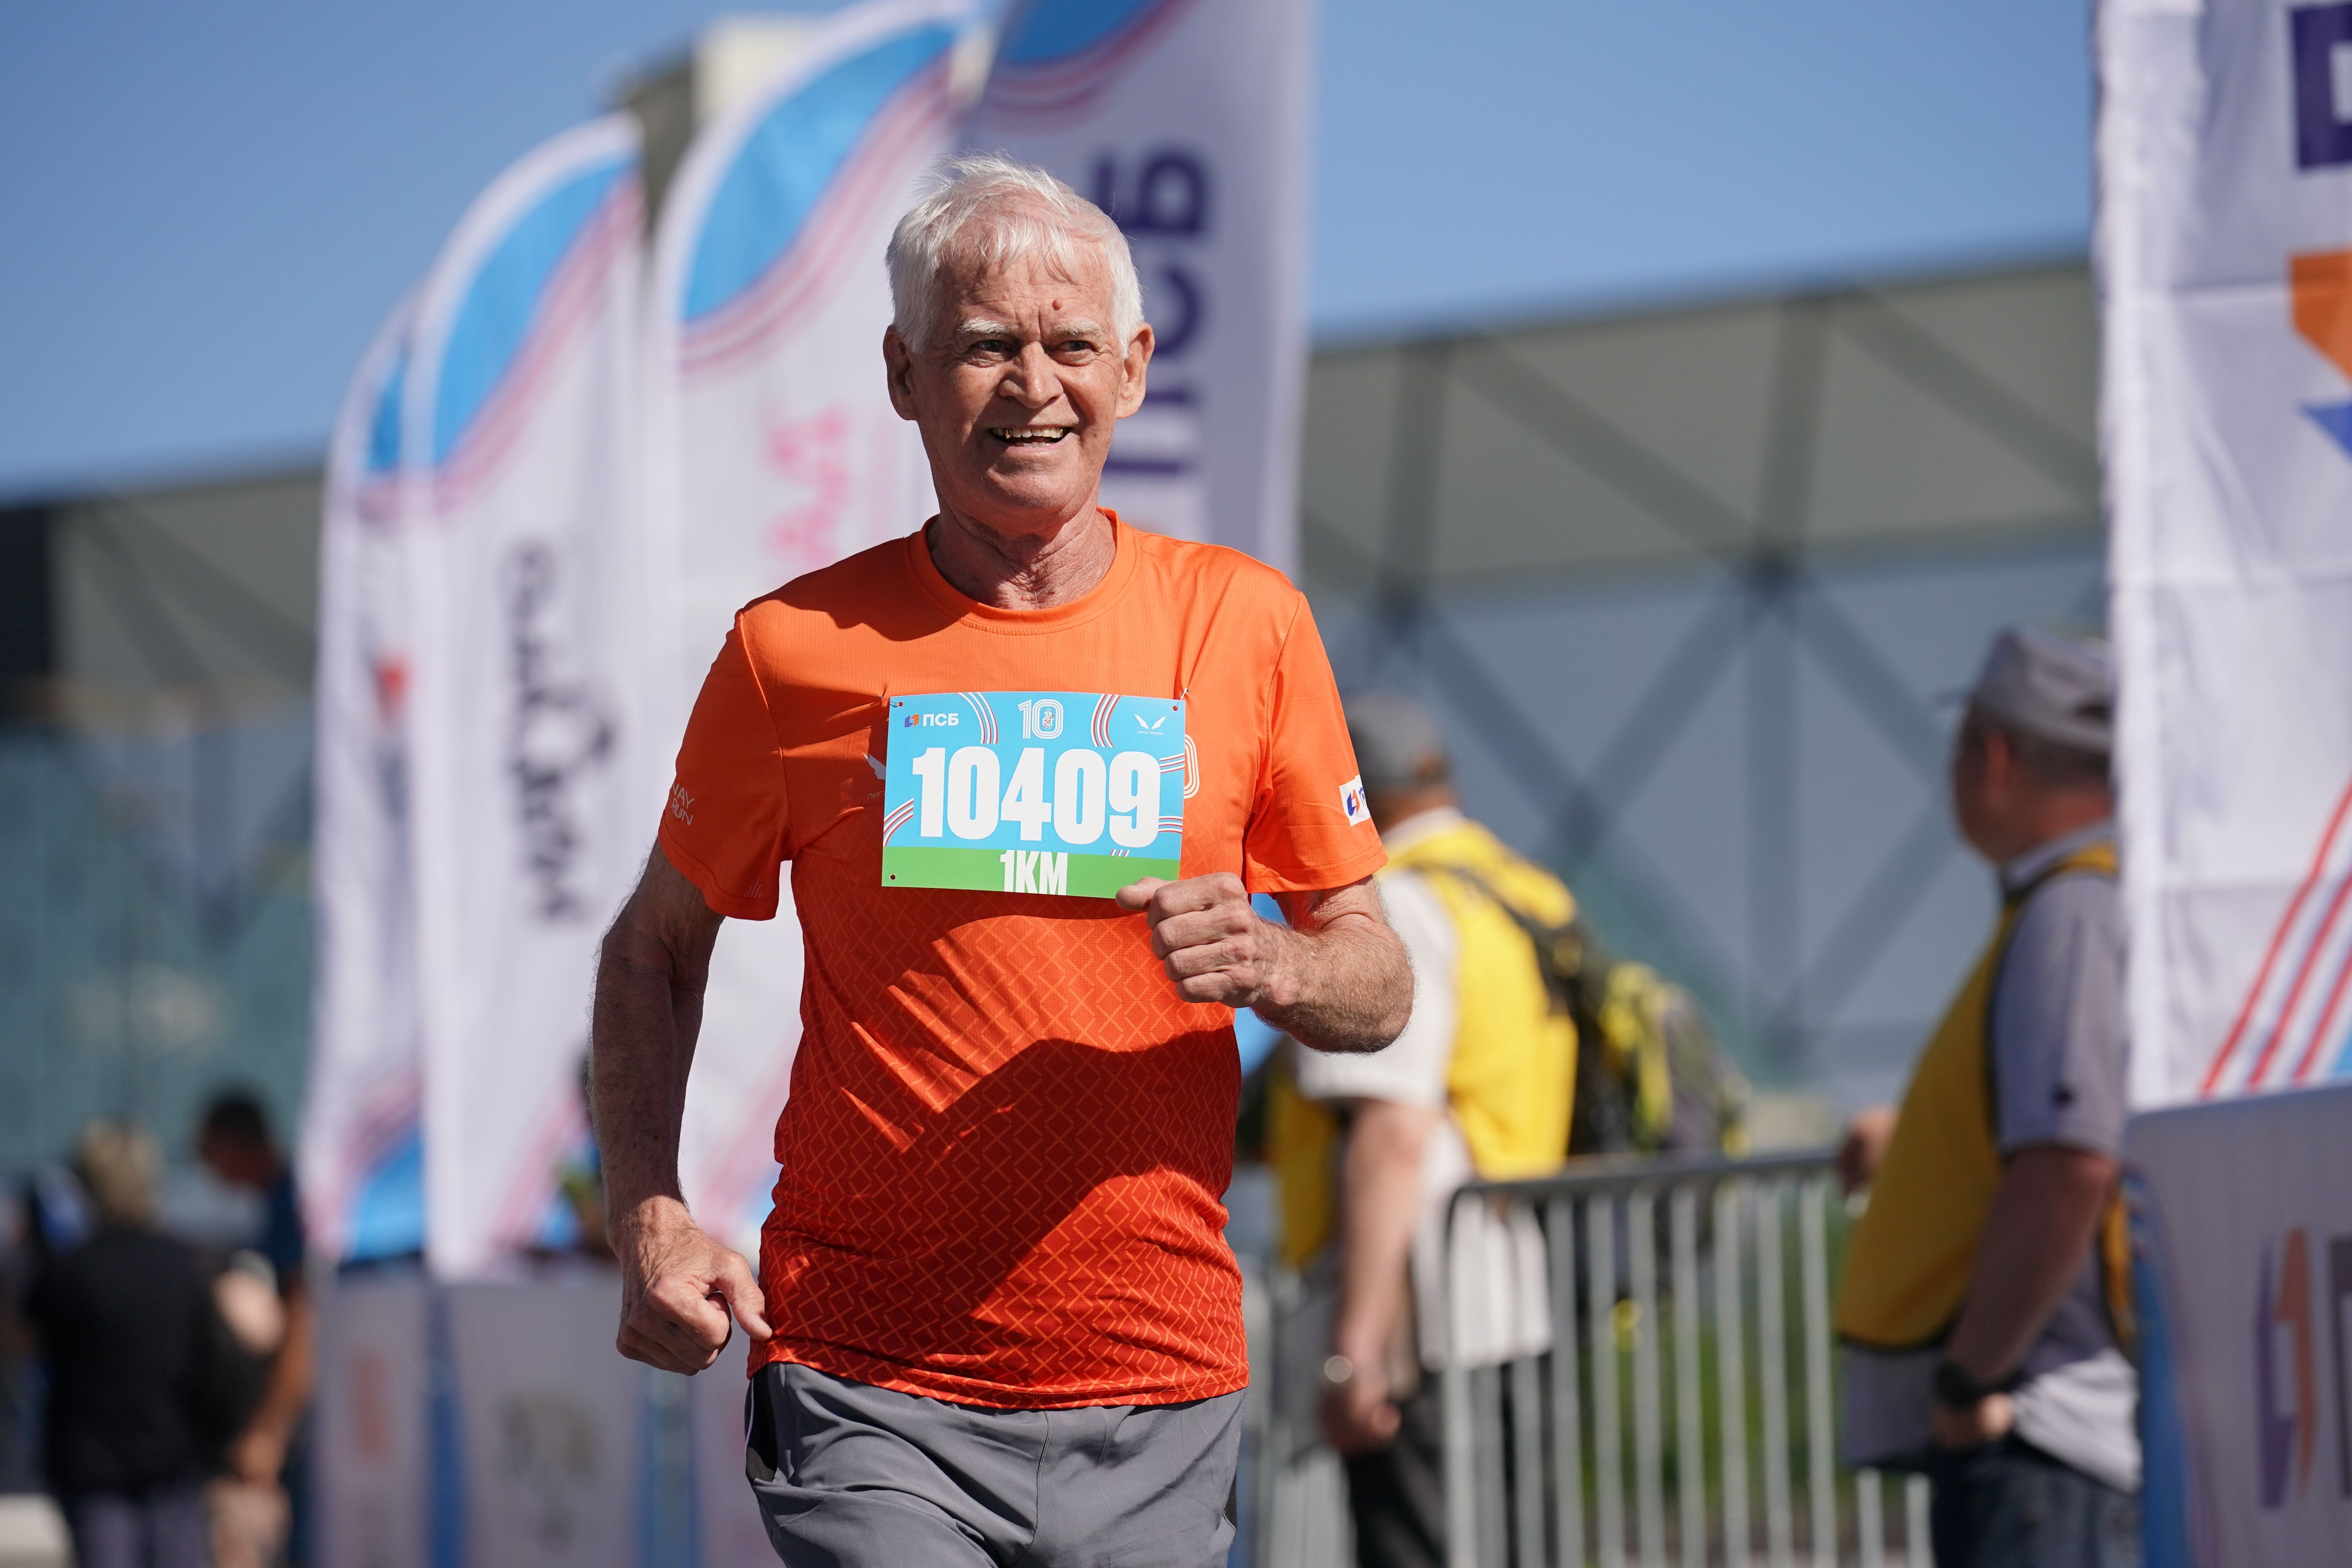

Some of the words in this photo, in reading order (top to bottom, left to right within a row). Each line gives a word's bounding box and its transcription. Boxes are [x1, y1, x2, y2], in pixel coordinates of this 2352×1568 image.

[922, 713, 959, 727] ПСБ
[1017, 699, 1064, 739] 10
[867, 791, 885, 800] ЛИГ
[912, 746, 1161, 848] 10409
[671, 797, 693, 826] RUN
